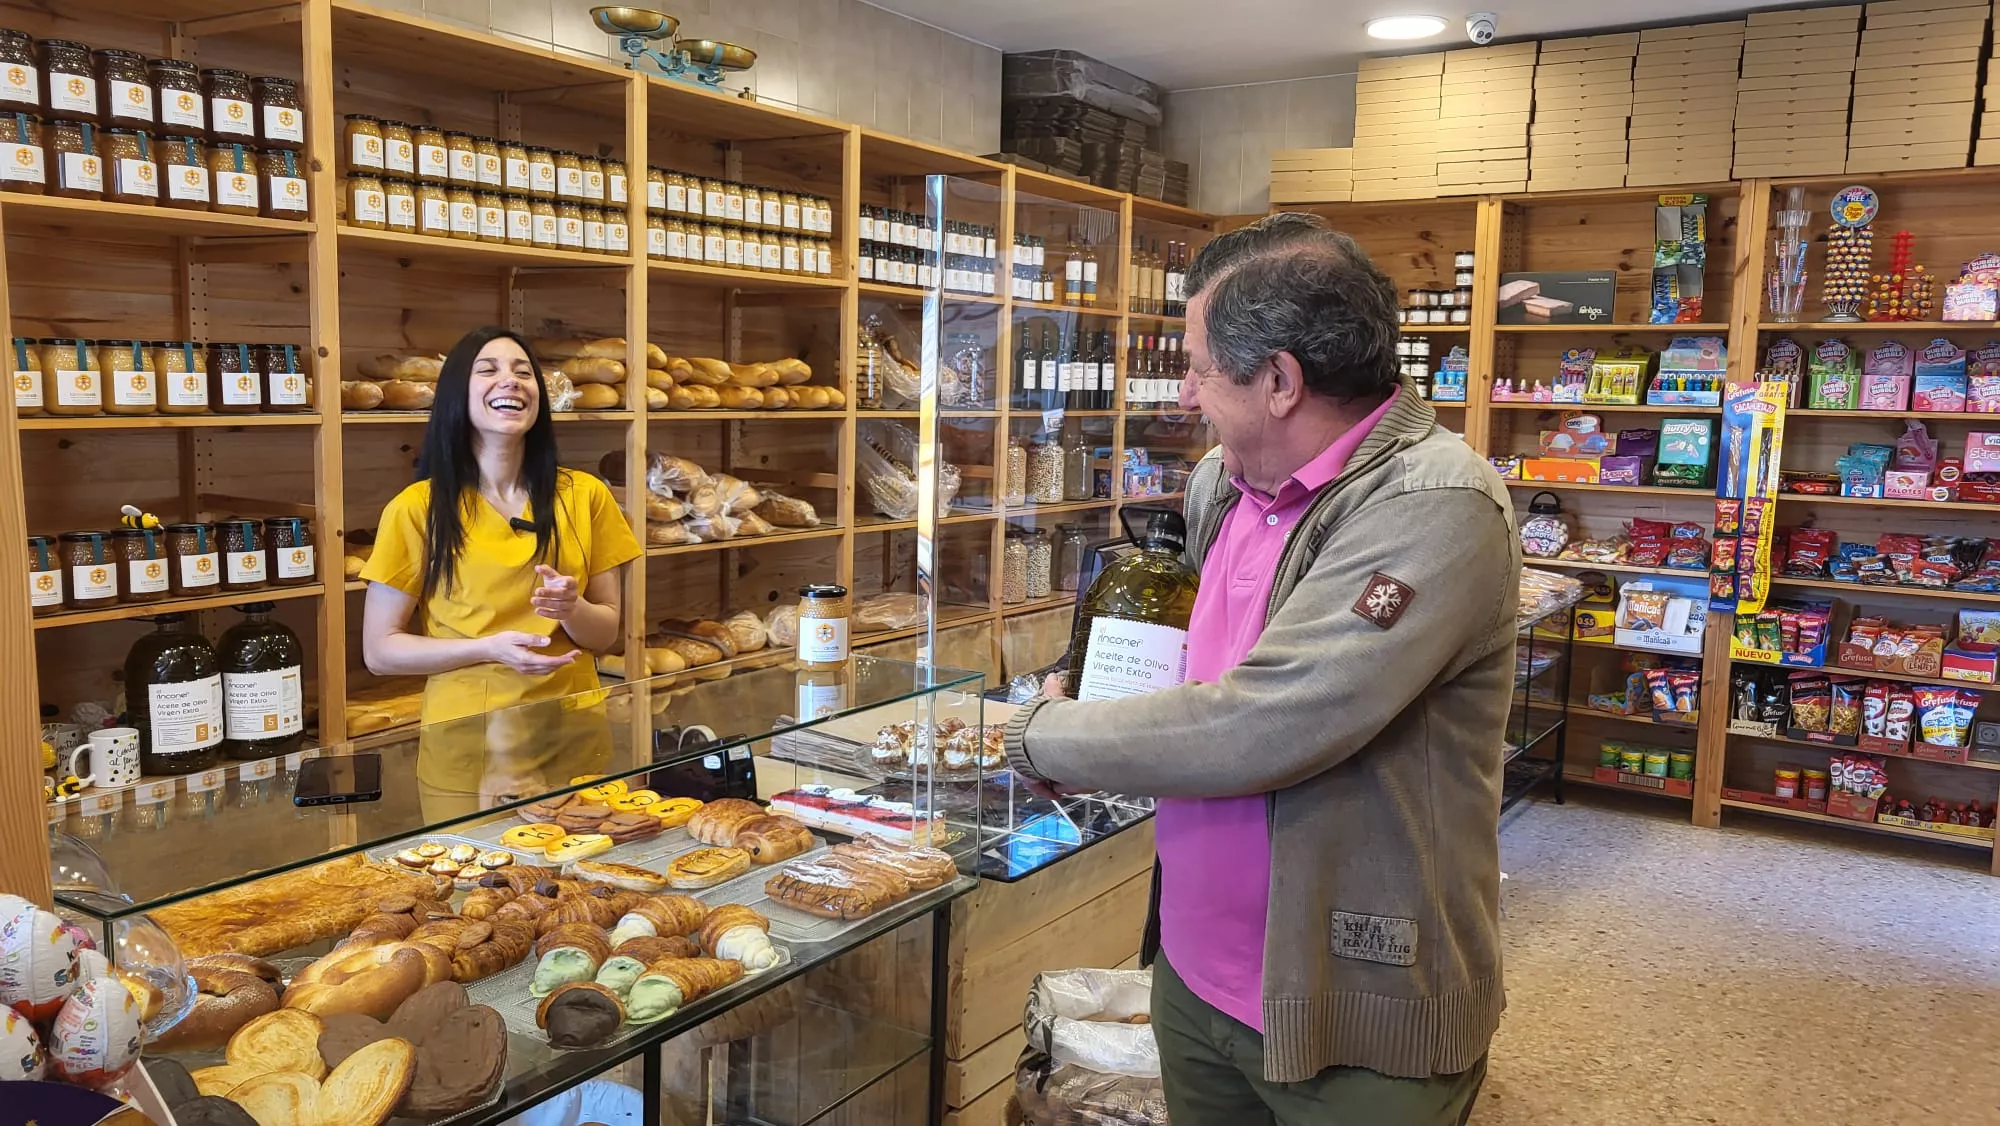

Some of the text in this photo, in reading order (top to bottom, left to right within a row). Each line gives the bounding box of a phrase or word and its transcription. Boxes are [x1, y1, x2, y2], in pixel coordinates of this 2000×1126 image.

[1765, 383, 1781, 391] 1+1
[1735, 649, 1772, 660] NUEVO
[1840, 653, 1873, 662] Grefusa
[1094, 650, 1170, 672] Aceite de Oliva
[1093, 661, 1152, 679] Virgen Extra
[157, 706, 200, 717] Virgen Extra
[267, 716, 274, 726] 5
[199, 726, 206, 736] 5
